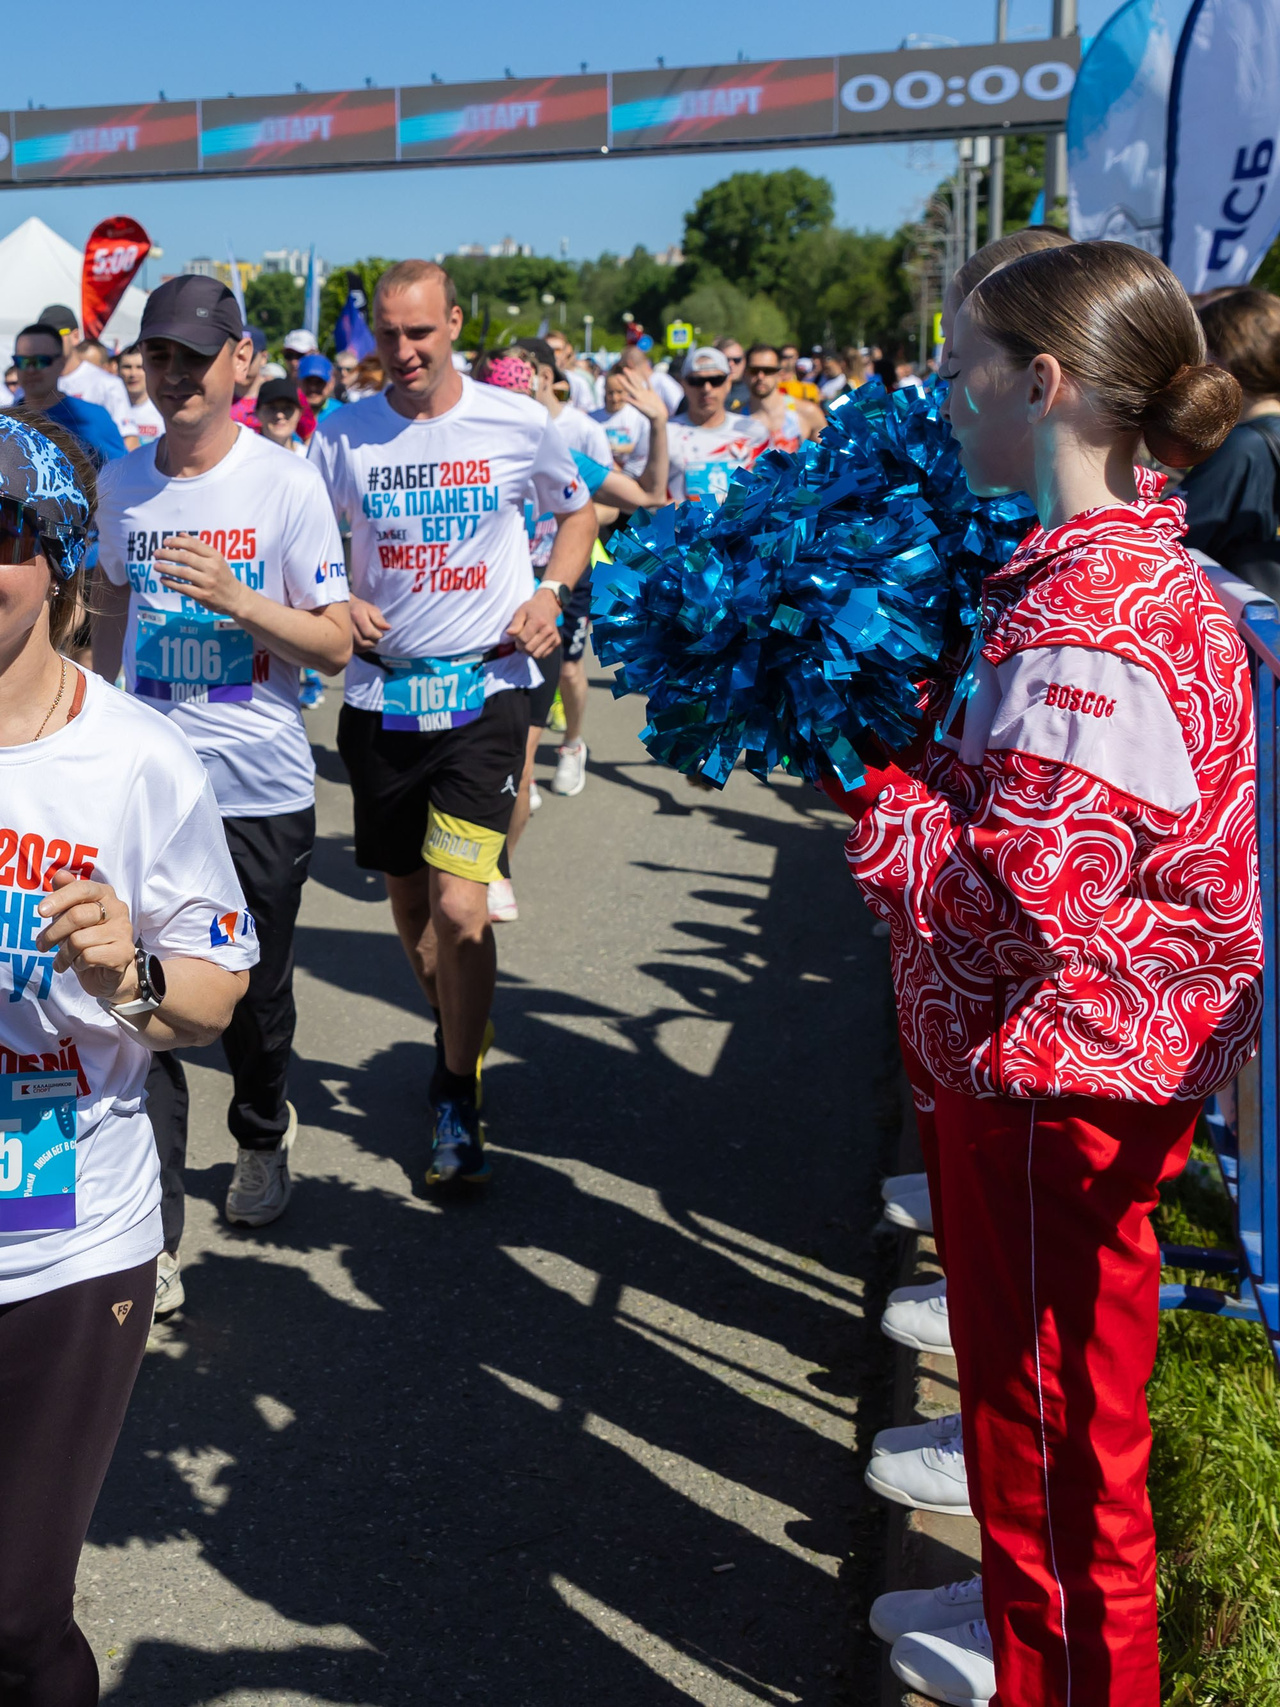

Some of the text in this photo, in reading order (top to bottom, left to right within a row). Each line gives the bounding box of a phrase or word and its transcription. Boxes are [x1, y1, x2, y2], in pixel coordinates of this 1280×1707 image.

[840, 61, 1077, 112] 00:00
[1207, 137, 1274, 270] ПСБ
[91, 245, 139, 275] 5:00
[368, 460, 491, 491] #ЗАБЕГ2025
[405, 486, 499, 517] ПЛАНЕТЫ
[127, 528, 256, 561] #ЗА2025
[421, 515, 481, 543] БЕГУТ
[330, 562, 347, 578] ПС
[378, 544, 449, 570] ВМЕСТЕ
[430, 561, 488, 593] ТОБОЙ
[159, 636, 222, 681] 1106
[408, 673, 459, 712] 1167
[428, 825, 482, 863] JORDAN
[32, 1081, 72, 1089] КАЛАШНИКОВ
[117, 1304, 128, 1316] FS
